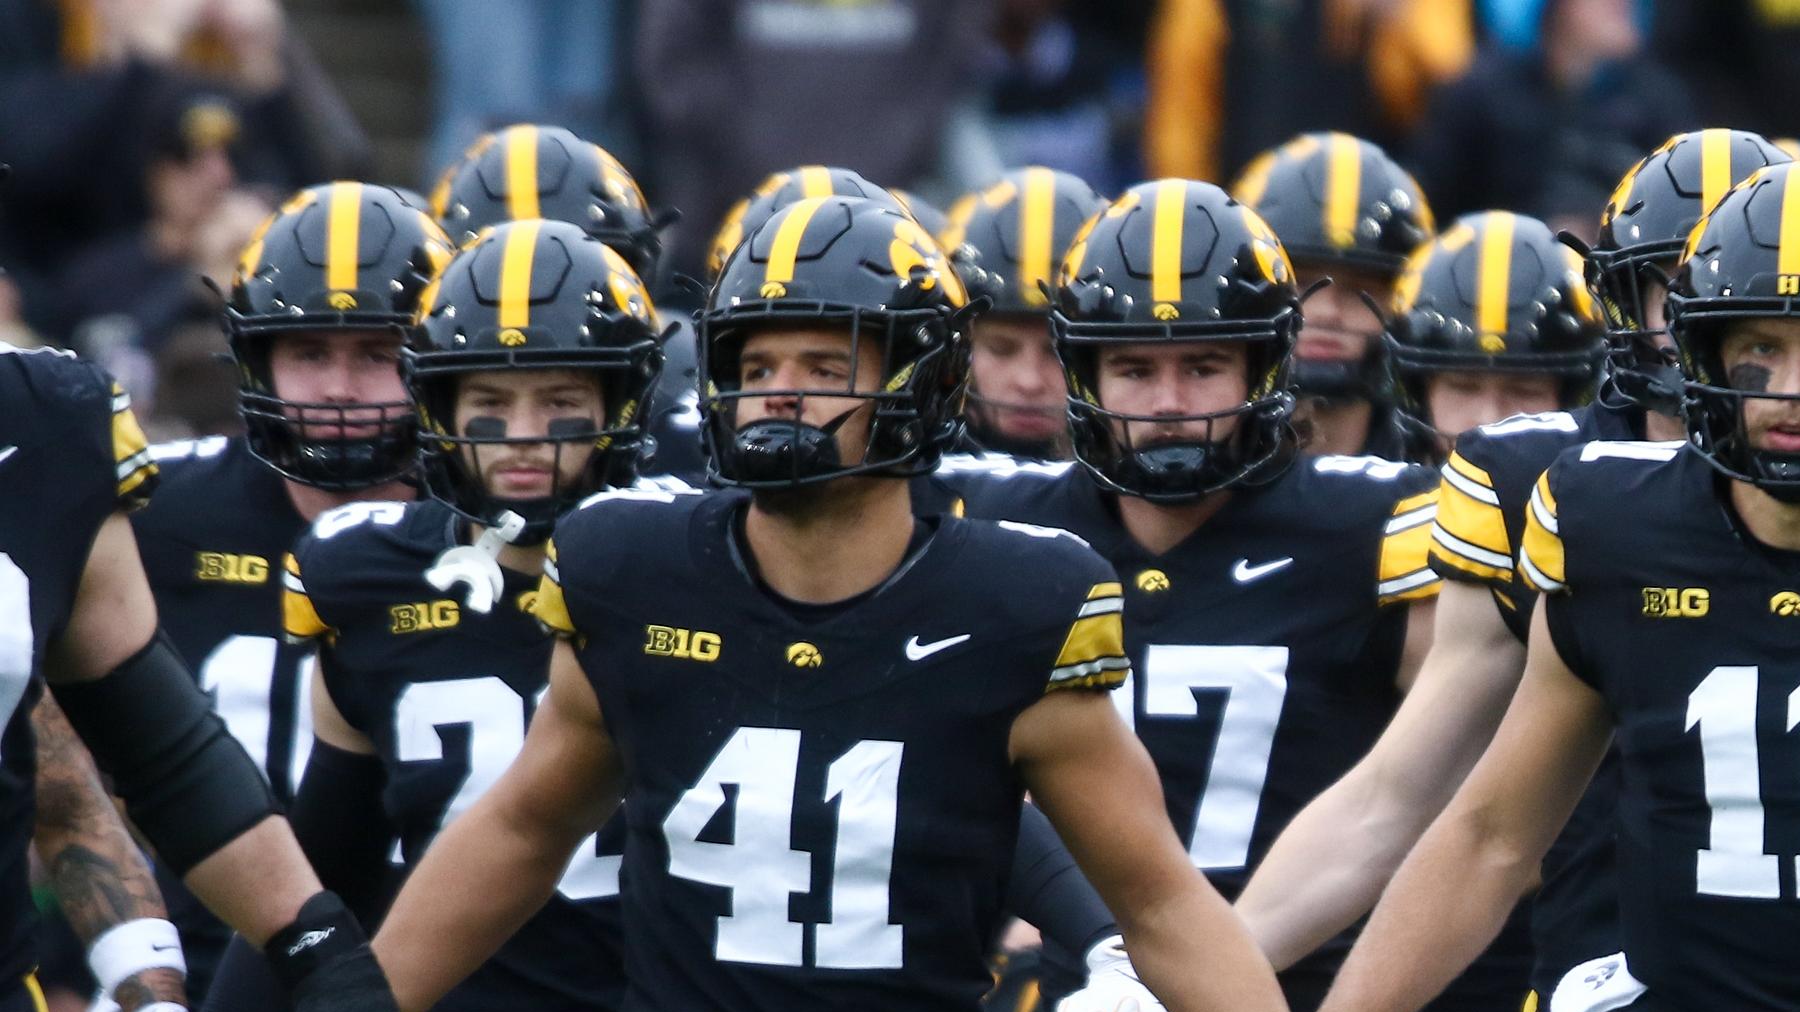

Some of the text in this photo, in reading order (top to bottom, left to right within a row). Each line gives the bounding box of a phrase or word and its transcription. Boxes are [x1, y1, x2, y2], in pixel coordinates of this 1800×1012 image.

[199, 634, 318, 796] 1
[1110, 644, 1290, 869] 7
[662, 726, 905, 971] 41
